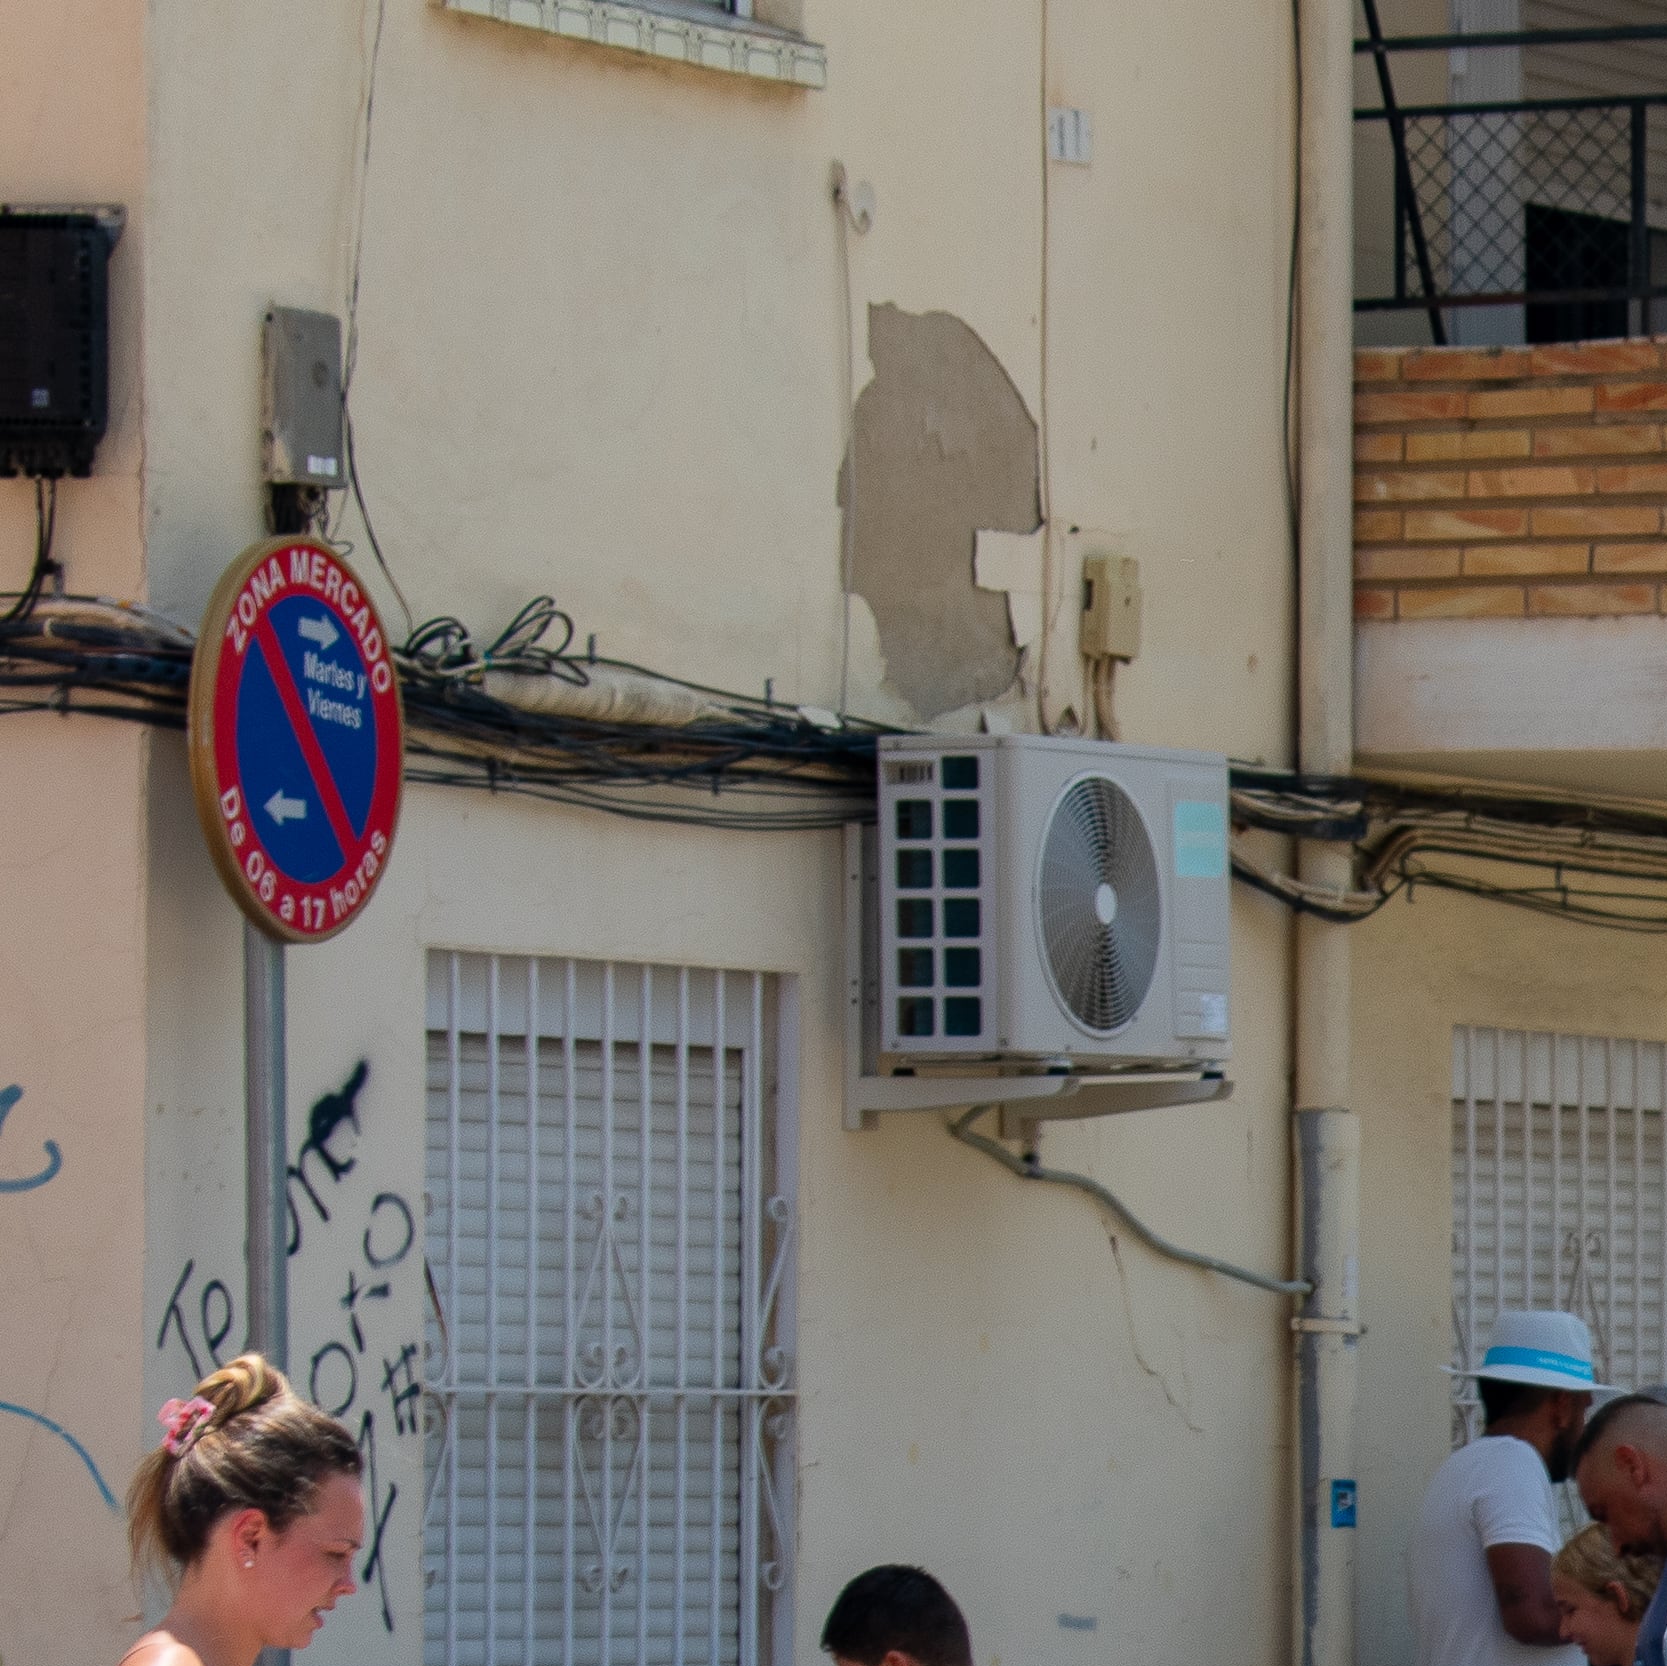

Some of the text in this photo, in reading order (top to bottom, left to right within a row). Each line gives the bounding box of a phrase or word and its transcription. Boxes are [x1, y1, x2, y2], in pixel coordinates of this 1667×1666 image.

[226, 547, 391, 694] ZONA MERCADO
[303, 650, 368, 699] Martes y
[306, 687, 362, 730] Viernes
[219, 784, 388, 930] De 06 a 17 horas
